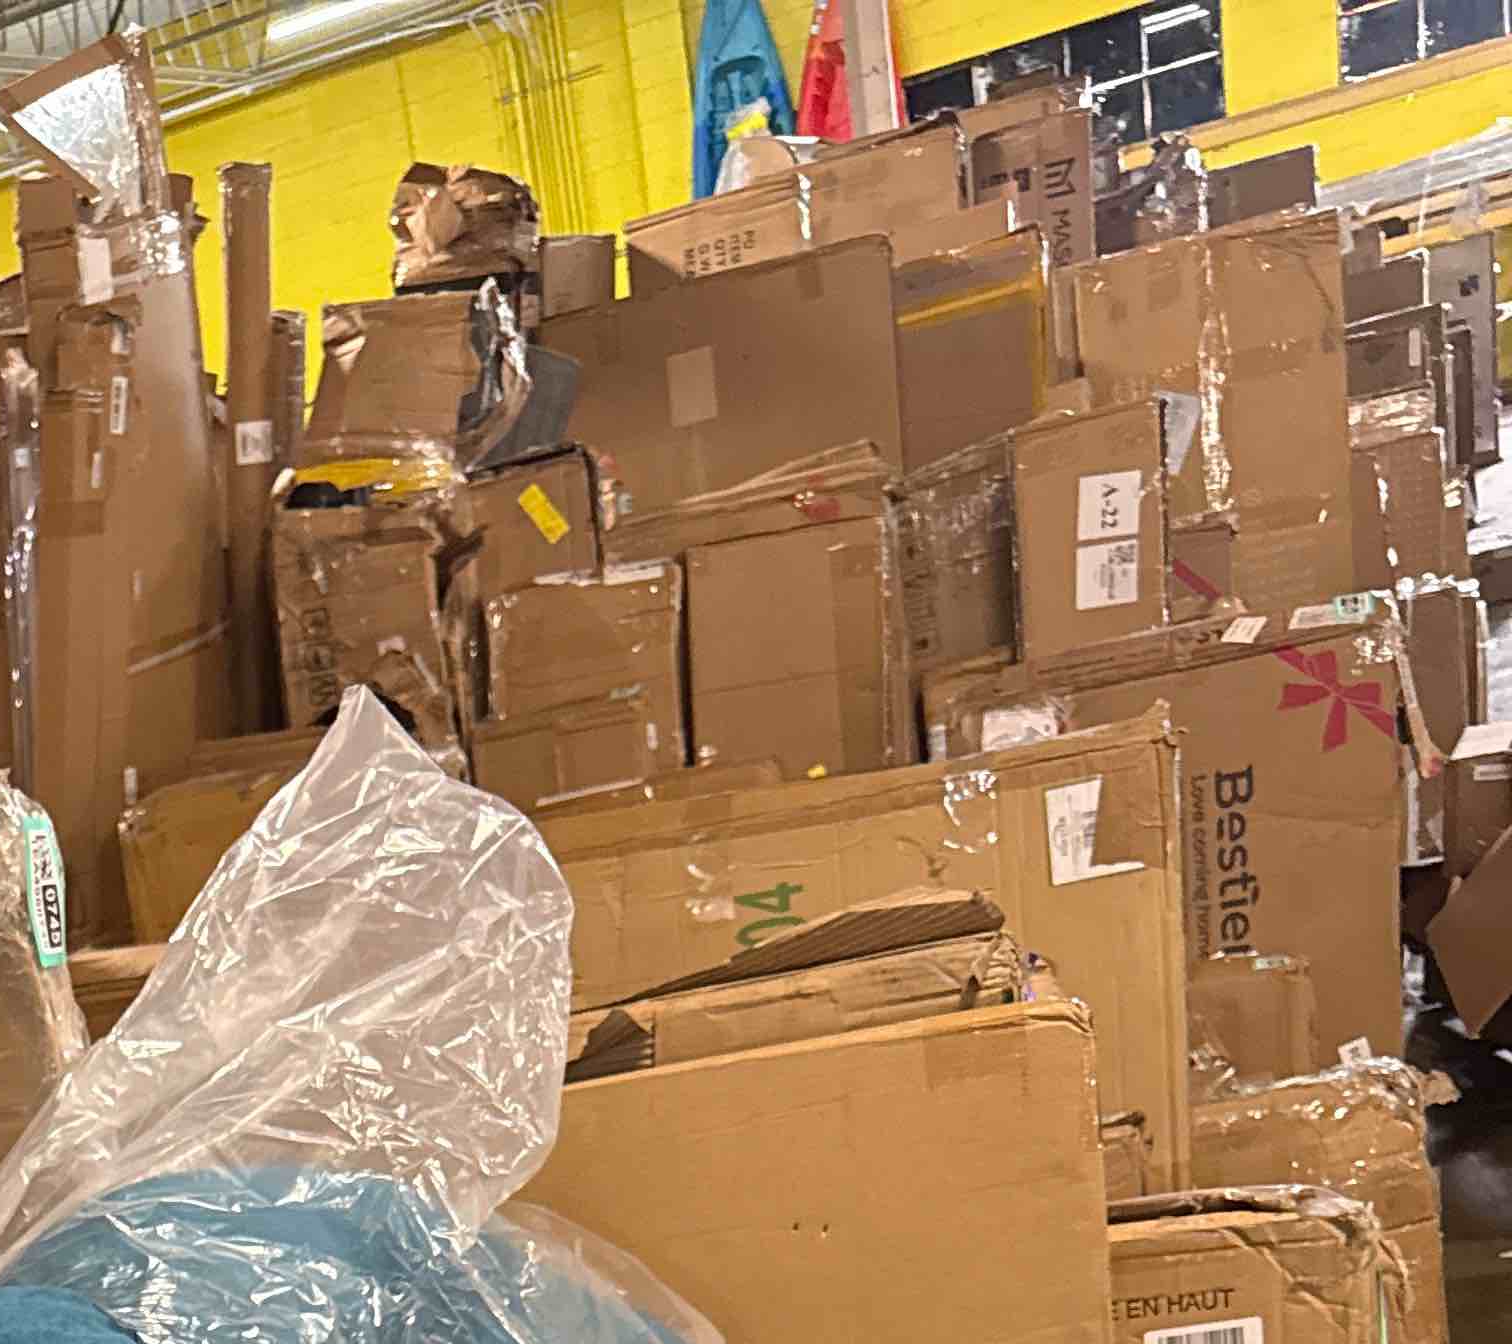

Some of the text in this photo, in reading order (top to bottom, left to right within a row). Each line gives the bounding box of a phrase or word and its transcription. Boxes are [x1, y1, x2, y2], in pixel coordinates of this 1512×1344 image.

[1100, 483, 1120, 530] A-22
[1126, 1296, 1161, 1320] EN
[1167, 1287, 1236, 1314] HAUT
